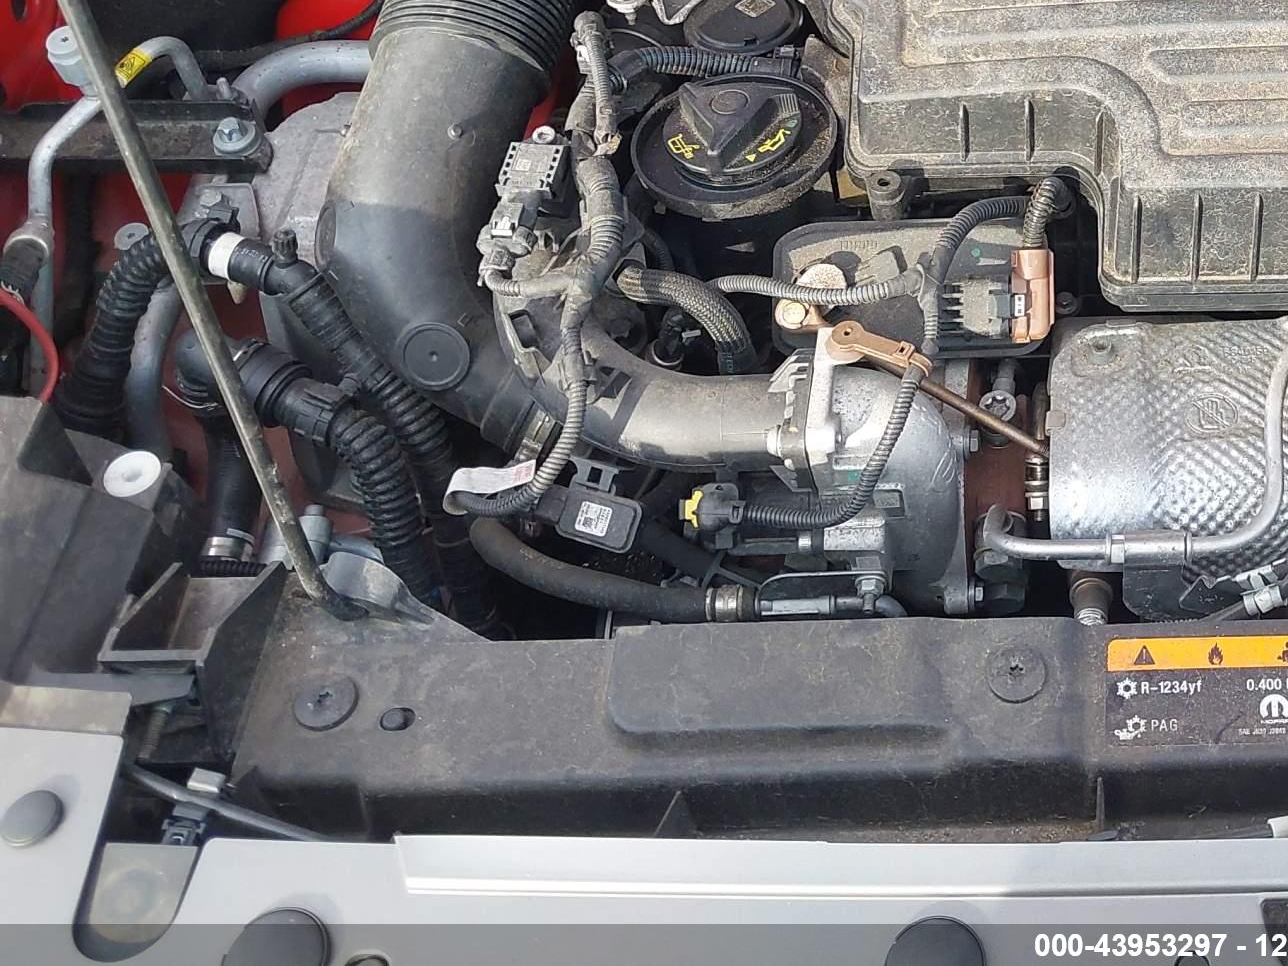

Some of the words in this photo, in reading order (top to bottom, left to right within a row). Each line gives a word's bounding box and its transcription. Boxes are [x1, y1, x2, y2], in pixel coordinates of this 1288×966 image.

[1141, 679, 1202, 695] R-1234yf
[1246, 678, 1282, 691] 0.400
[1151, 718, 1178, 731] PAG
